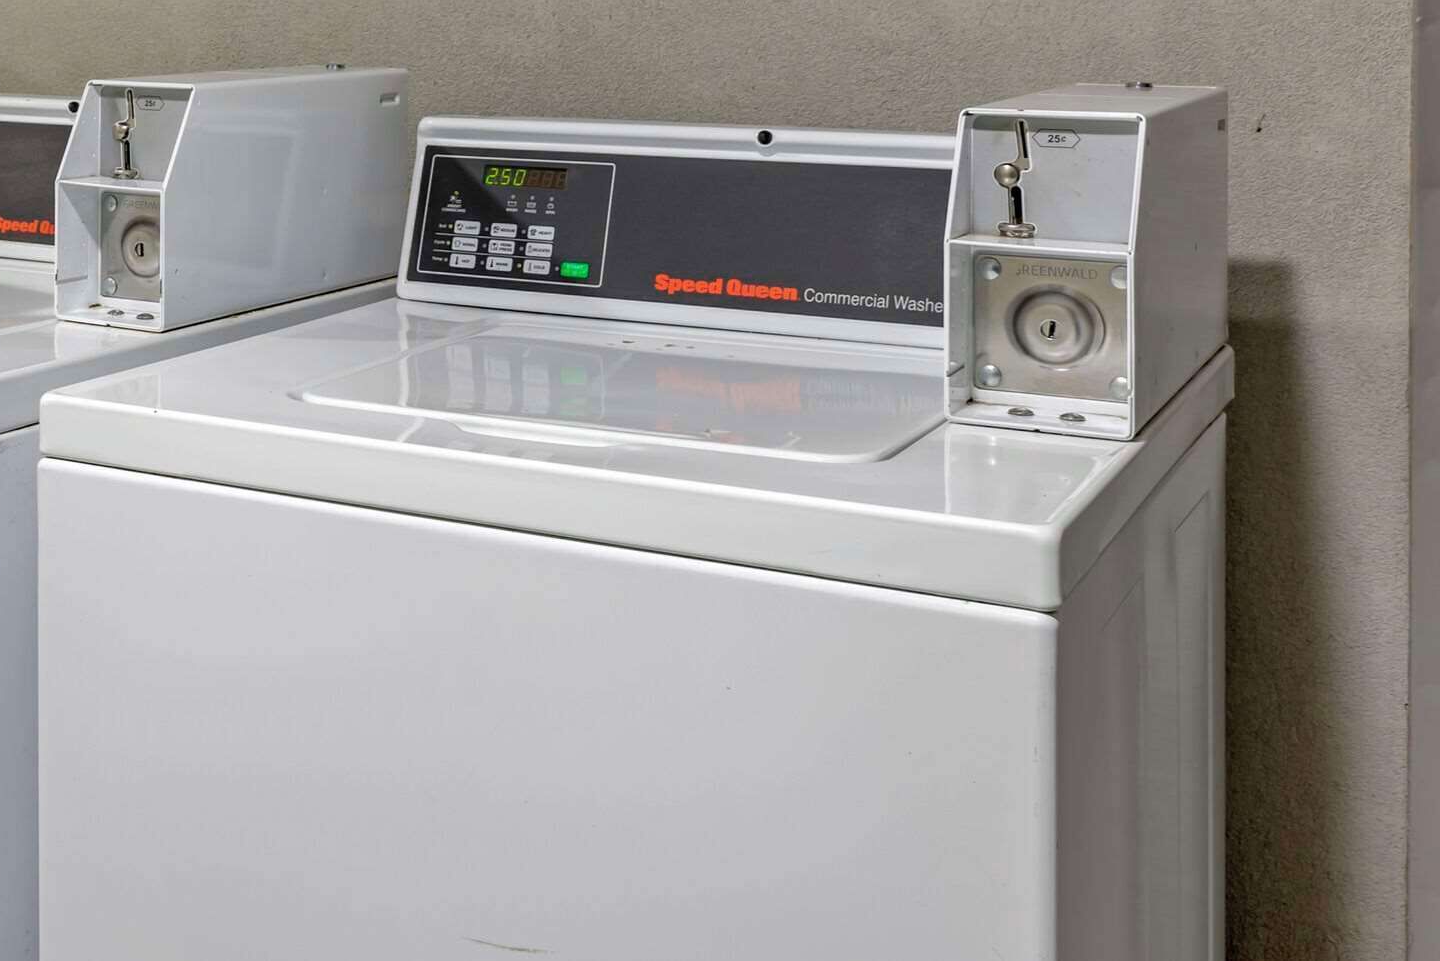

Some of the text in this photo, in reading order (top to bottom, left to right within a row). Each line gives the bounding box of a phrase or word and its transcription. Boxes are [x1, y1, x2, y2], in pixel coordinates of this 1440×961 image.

[484, 167, 527, 187] 2.50
[654, 273, 945, 313] Speed Queen Commercial Washe
